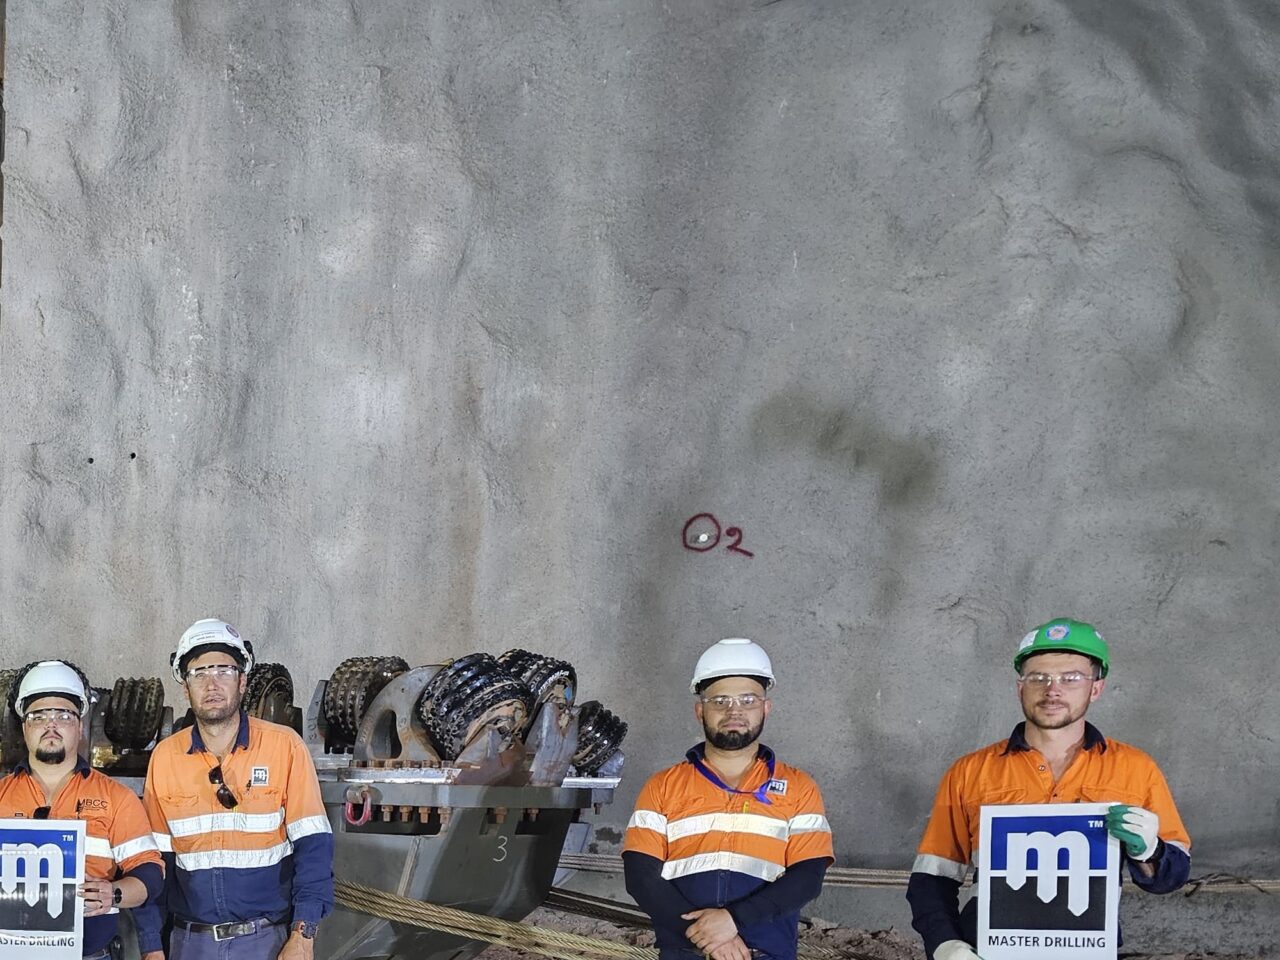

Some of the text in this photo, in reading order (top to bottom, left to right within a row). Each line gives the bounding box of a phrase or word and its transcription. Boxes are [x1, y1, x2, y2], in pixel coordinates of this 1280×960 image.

[1088, 820, 1104, 828] TM
[492, 835, 508, 862] 3
[29, 935, 75, 948] DRILLING
[988, 935, 1106, 949] MASTER DRILLING
